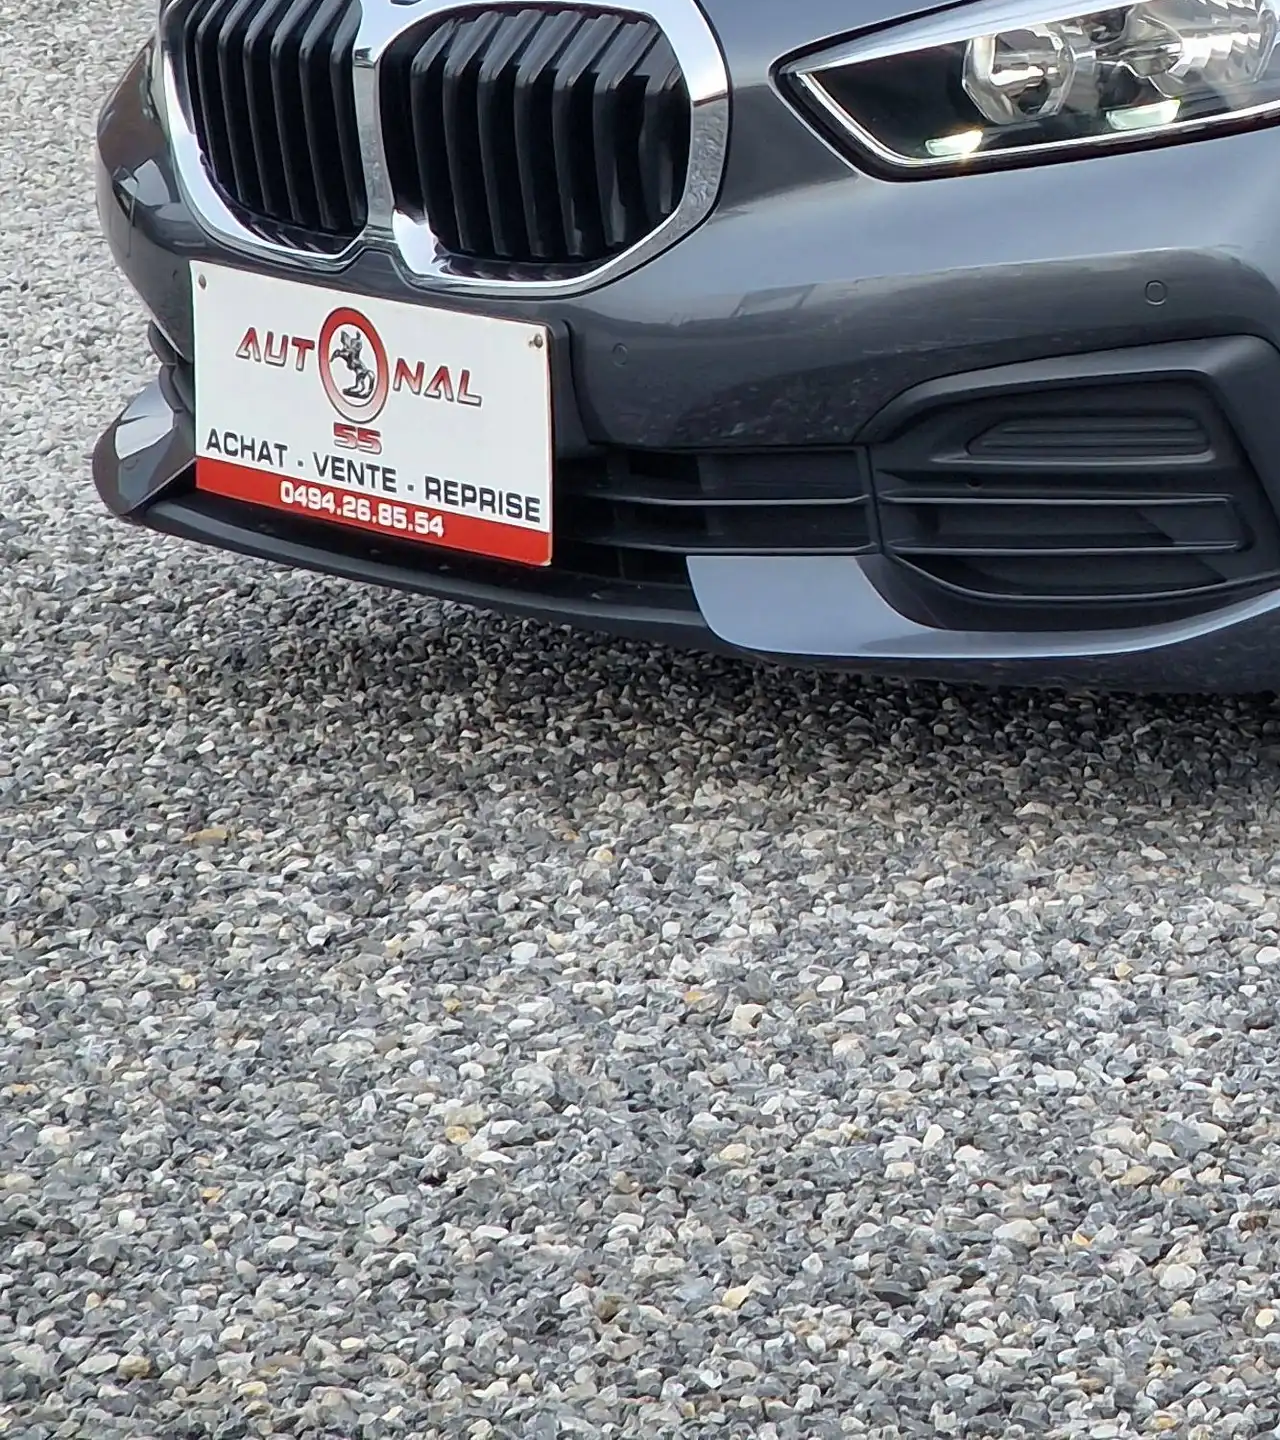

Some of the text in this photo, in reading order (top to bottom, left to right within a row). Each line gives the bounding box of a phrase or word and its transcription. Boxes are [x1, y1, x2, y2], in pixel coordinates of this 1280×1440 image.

[333, 422, 382, 455] 55
[206, 428, 288, 468] ACHAT
[313, 451, 398, 493] VENTE
[425, 476, 541, 523] REPRISE
[280, 480, 444, 538] 0494.26.85.54
